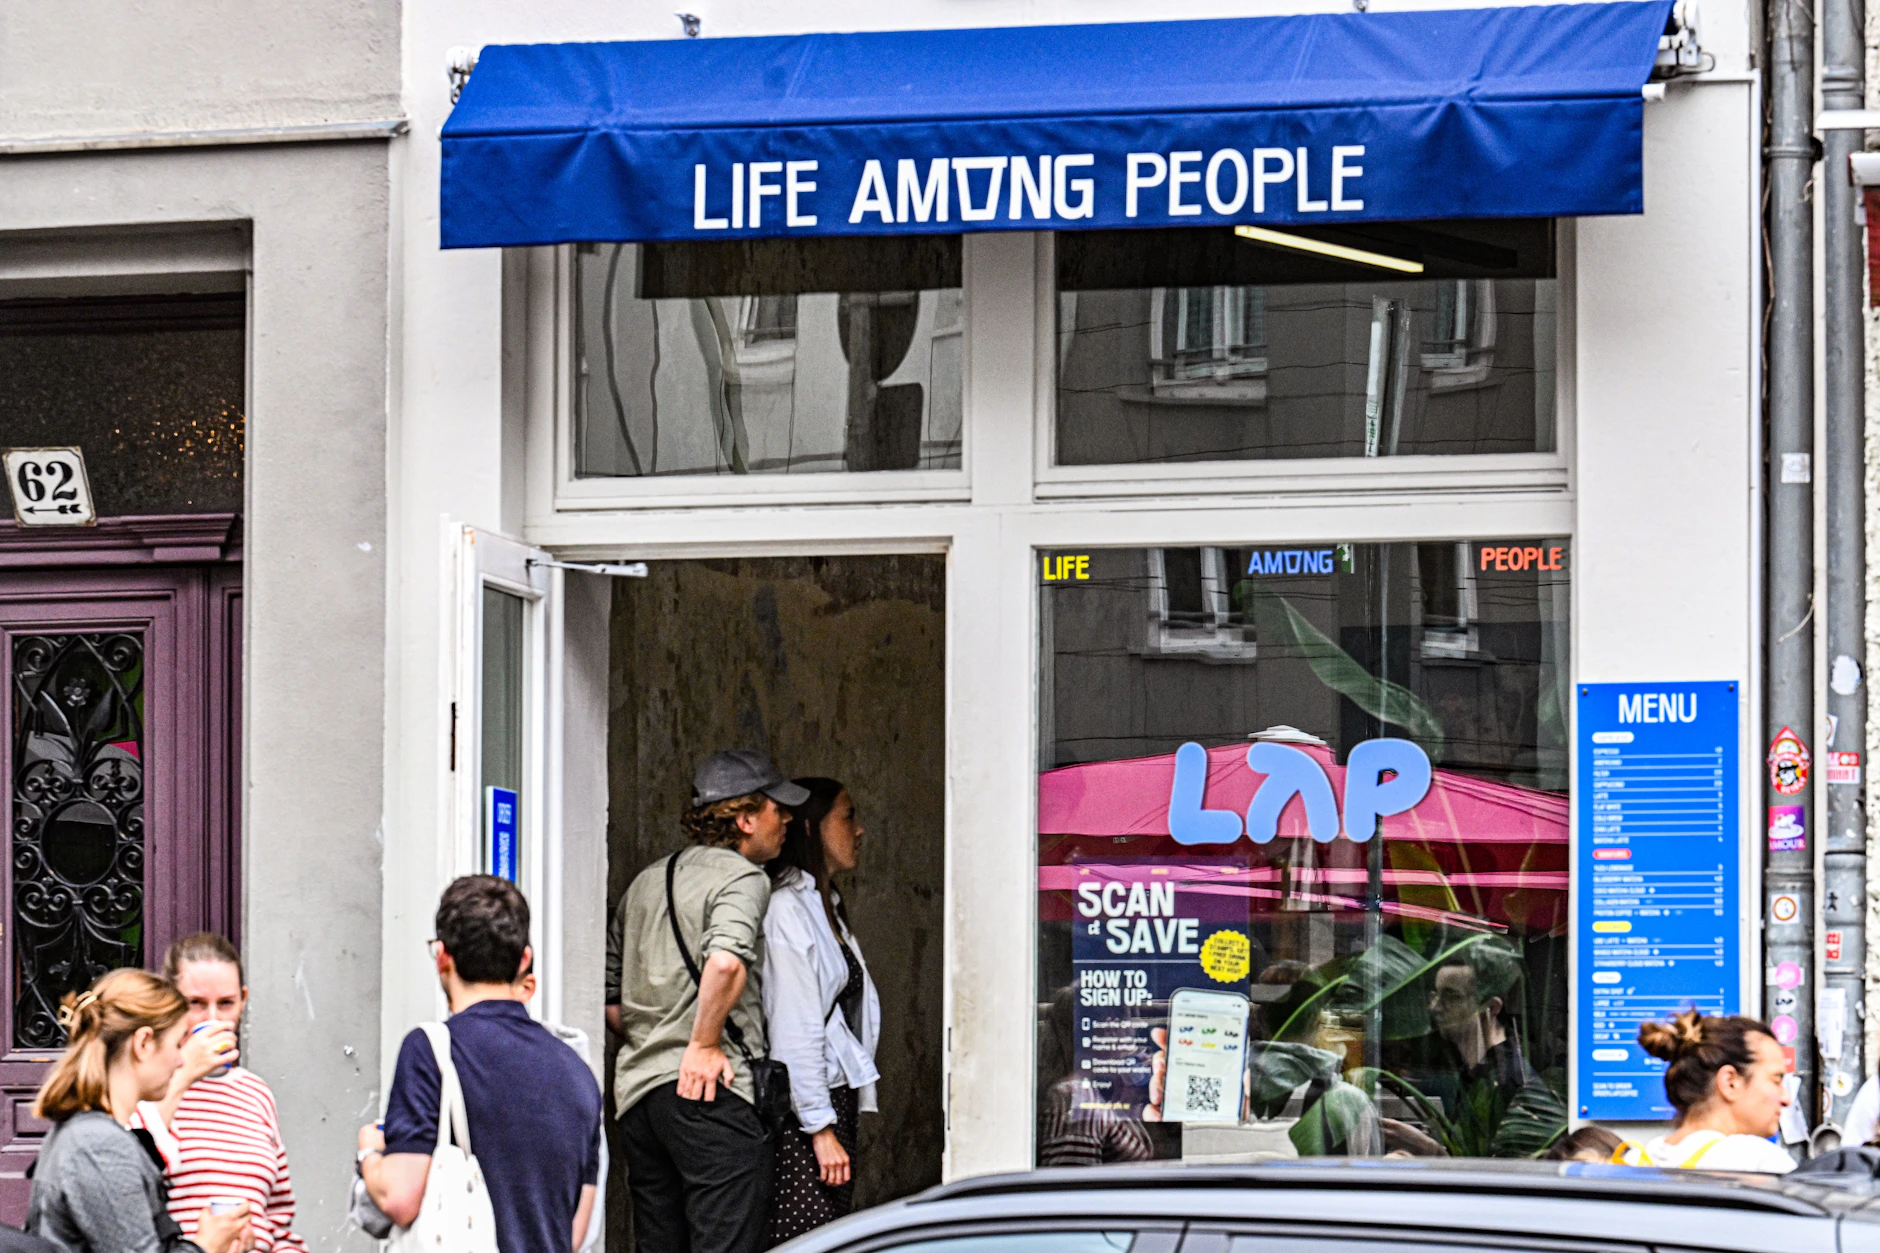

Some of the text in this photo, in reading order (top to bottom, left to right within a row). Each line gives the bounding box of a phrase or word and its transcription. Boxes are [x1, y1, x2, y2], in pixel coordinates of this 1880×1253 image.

[693, 159, 818, 230] LIFE
[1125, 145, 1366, 218] PEOPLE
[18, 460, 77, 502] 62
[1043, 555, 1090, 581] LIFE
[1480, 547, 1563, 571] PEOPLE
[1618, 693, 1697, 724] MENU
[1168, 737, 1432, 845] LAP
[1078, 881, 1175, 918] SCAN
[1106, 918, 1199, 954] SAVE
[1080, 969, 1148, 988] HOW TO
[1080, 988, 1153, 1007] SIGN UP:
